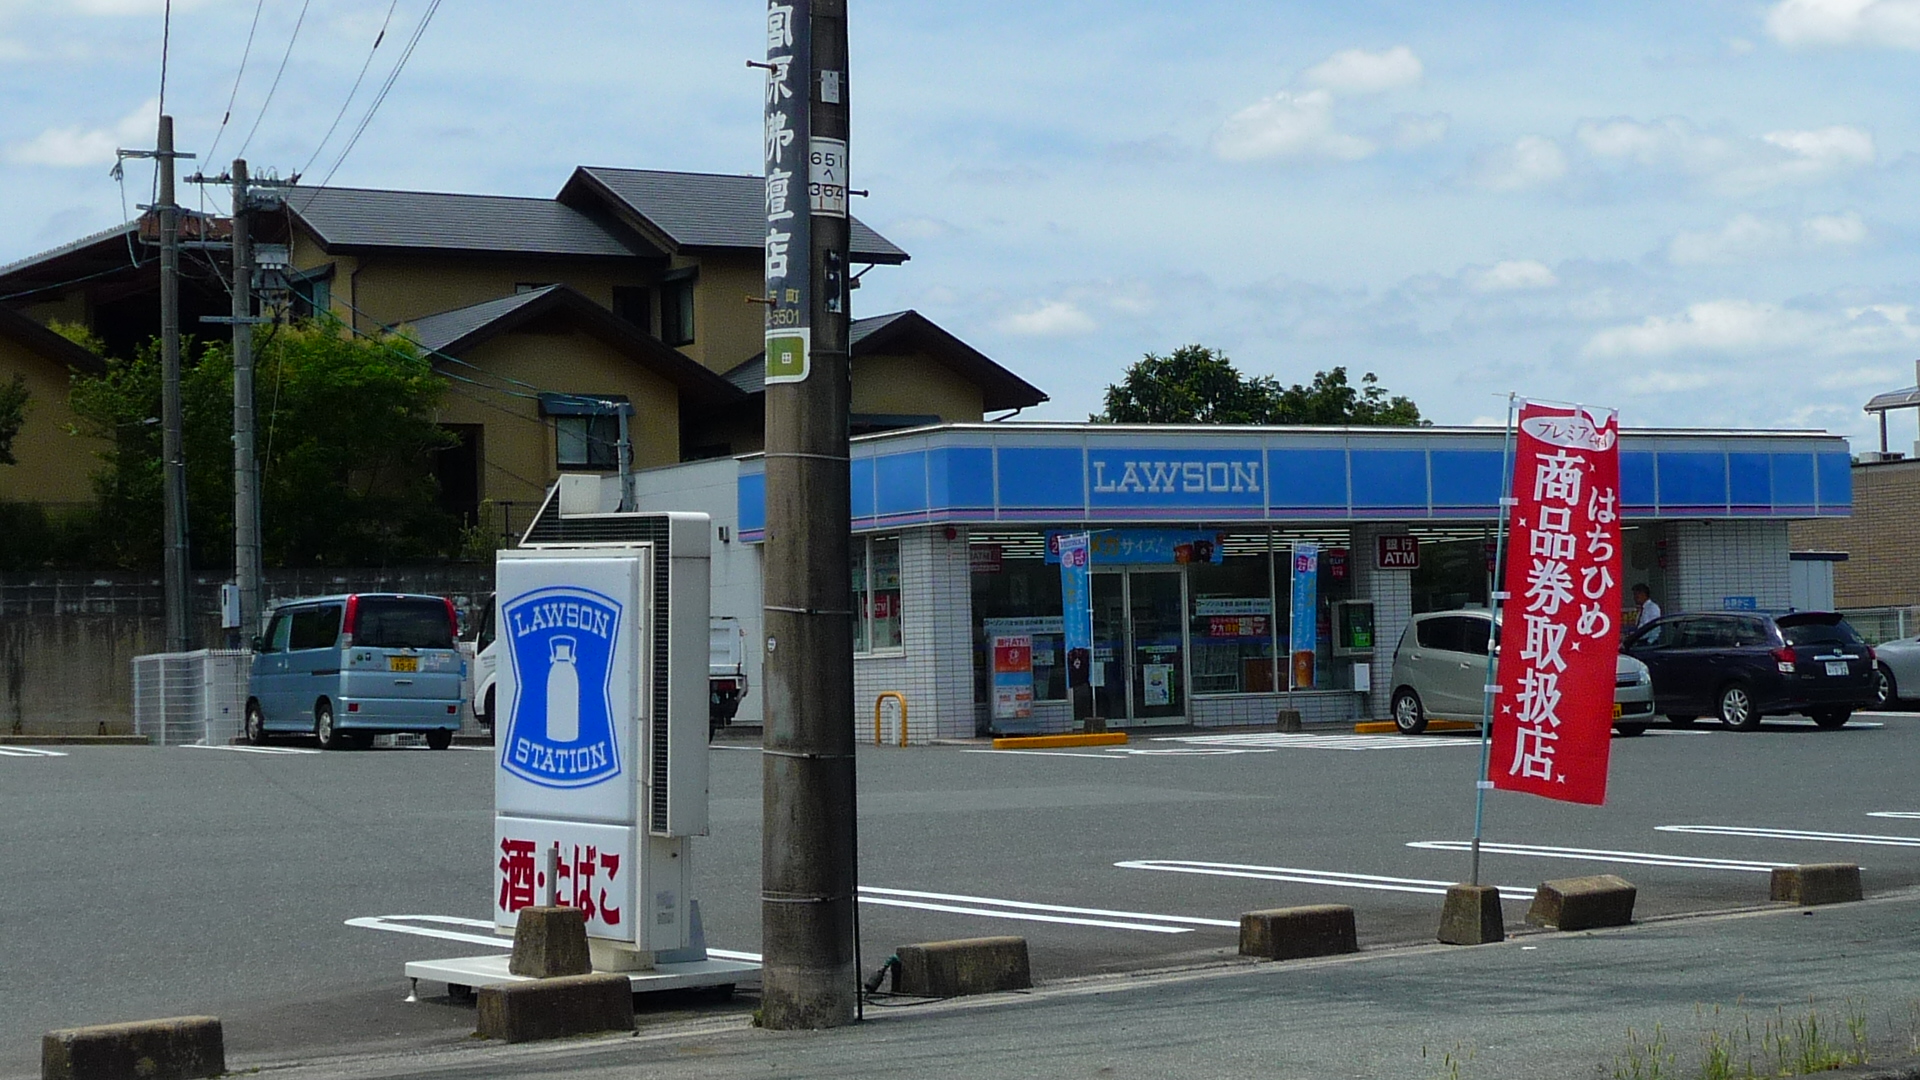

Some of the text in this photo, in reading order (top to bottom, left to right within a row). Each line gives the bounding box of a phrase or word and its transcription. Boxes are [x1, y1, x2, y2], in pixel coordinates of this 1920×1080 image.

[810, 152, 844, 168] 651
[809, 181, 844, 199] 364
[1092, 461, 1261, 493] LAWSON
[1384, 552, 1416, 565] ATM
[1385, 538, 1413, 551] 銀行
[1576, 485, 1617, 640] はちひめ
[513, 602, 610, 638] LAWSON
[1508, 449, 1585, 783] 商品券取扱店
[515, 737, 608, 776] STATION
